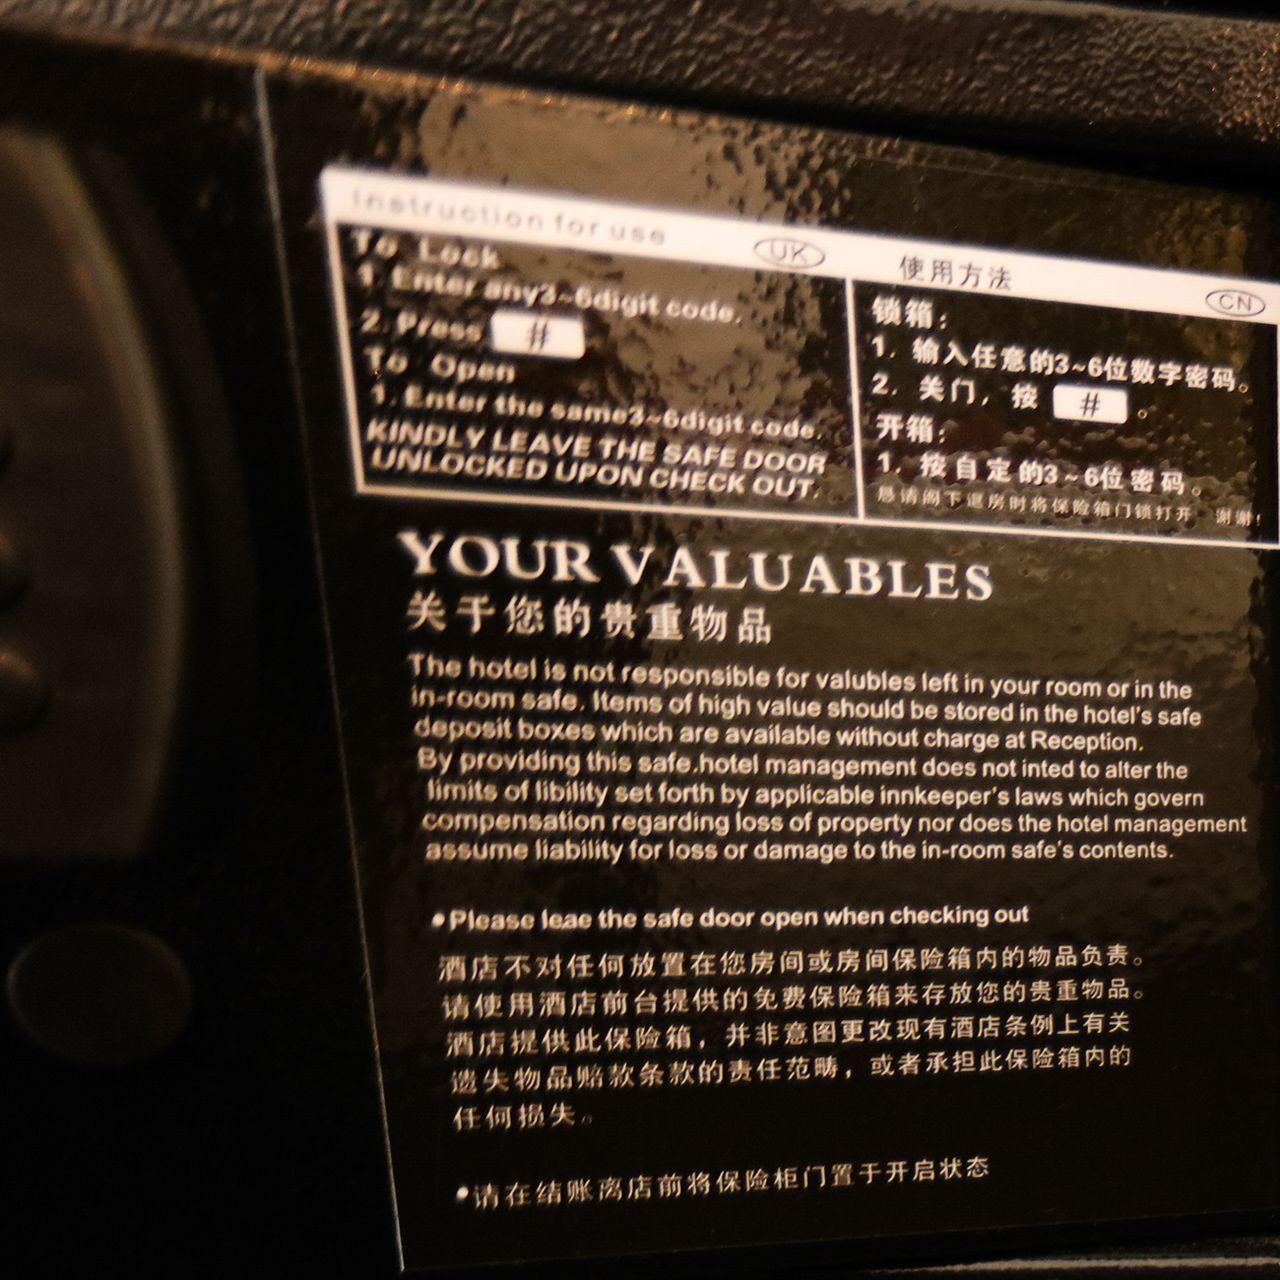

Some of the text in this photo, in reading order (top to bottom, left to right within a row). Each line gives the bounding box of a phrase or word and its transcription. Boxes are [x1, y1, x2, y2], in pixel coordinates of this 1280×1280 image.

[353, 188, 666, 246] Instruction for use
[417, 234, 499, 270] Lock
[899, 254, 1013, 291] 使用方法
[397, 307, 483, 343] Press
[431, 352, 516, 384] Open
[404, 384, 487, 414] Enter
[494, 393, 545, 419] the
[366, 417, 829, 477] KINDLY LEAVE THE SAFE DOOR
[371, 447, 549, 481] UNLOCKED
[555, 460, 644, 489] UPON
[649, 467, 747, 495] CHECK
[396, 530, 995, 603] YOUR VALUABLES
[405, 592, 773, 645] 关于您的贵重物品
[407, 654, 1194, 700] The hotel is not responsible for valubles left in your room or in the
[409, 689, 515, 709] in-room
[521, 687, 584, 712] safe.
[592, 689, 663, 714] Items
[668, 692, 693, 714] of
[698, 692, 751, 720] high
[756, 695, 822, 717] value
[827, 697, 905, 719] should
[910, 699, 939, 720] be
[944, 695, 1014, 722] stored
[1019, 702, 1039, 722] in
[1044, 702, 1079, 723] the
[1157, 705, 1204, 726] safe
[413, 716, 1146, 754] deposit boxes which are available without charge at Reception.
[417, 746, 453, 776] By
[459, 749, 581, 777] providing
[586, 750, 632, 773] this
[765, 756, 917, 780] management
[922, 757, 977, 777] does
[982, 758, 1017, 778] not
[1021, 758, 1075, 779] inted
[1079, 760, 1100, 779] to
[1105, 759, 1152, 779] alter
[1155, 760, 1190, 780] the
[426, 778, 498, 802] limits
[503, 779, 529, 802] of
[535, 780, 609, 808] libility
[614, 782, 653, 803] set
[658, 781, 715, 803] forth
[720, 782, 750, 809] by
[755, 779, 875, 809] applicable
[1015, 786, 1064, 806] laws
[1068, 786, 1129, 806] which
[1133, 792, 1206, 811] govern
[421, 810, 1249, 837] compensation regarding loss of property nor does the hotel management
[424, 842, 529, 861] assume
[535, 838, 624, 865] liability
[629, 835, 663, 860] for
[668, 839, 718, 860] loss
[723, 843, 748, 860] or
[753, 839, 848, 865] damage
[853, 840, 876, 860] to
[880, 835, 917, 860] the
[921, 840, 1006, 860] in-room
[1079, 835, 1177, 859] contents.
[448, 905, 1032, 931] Please leae the safe door open when checking out
